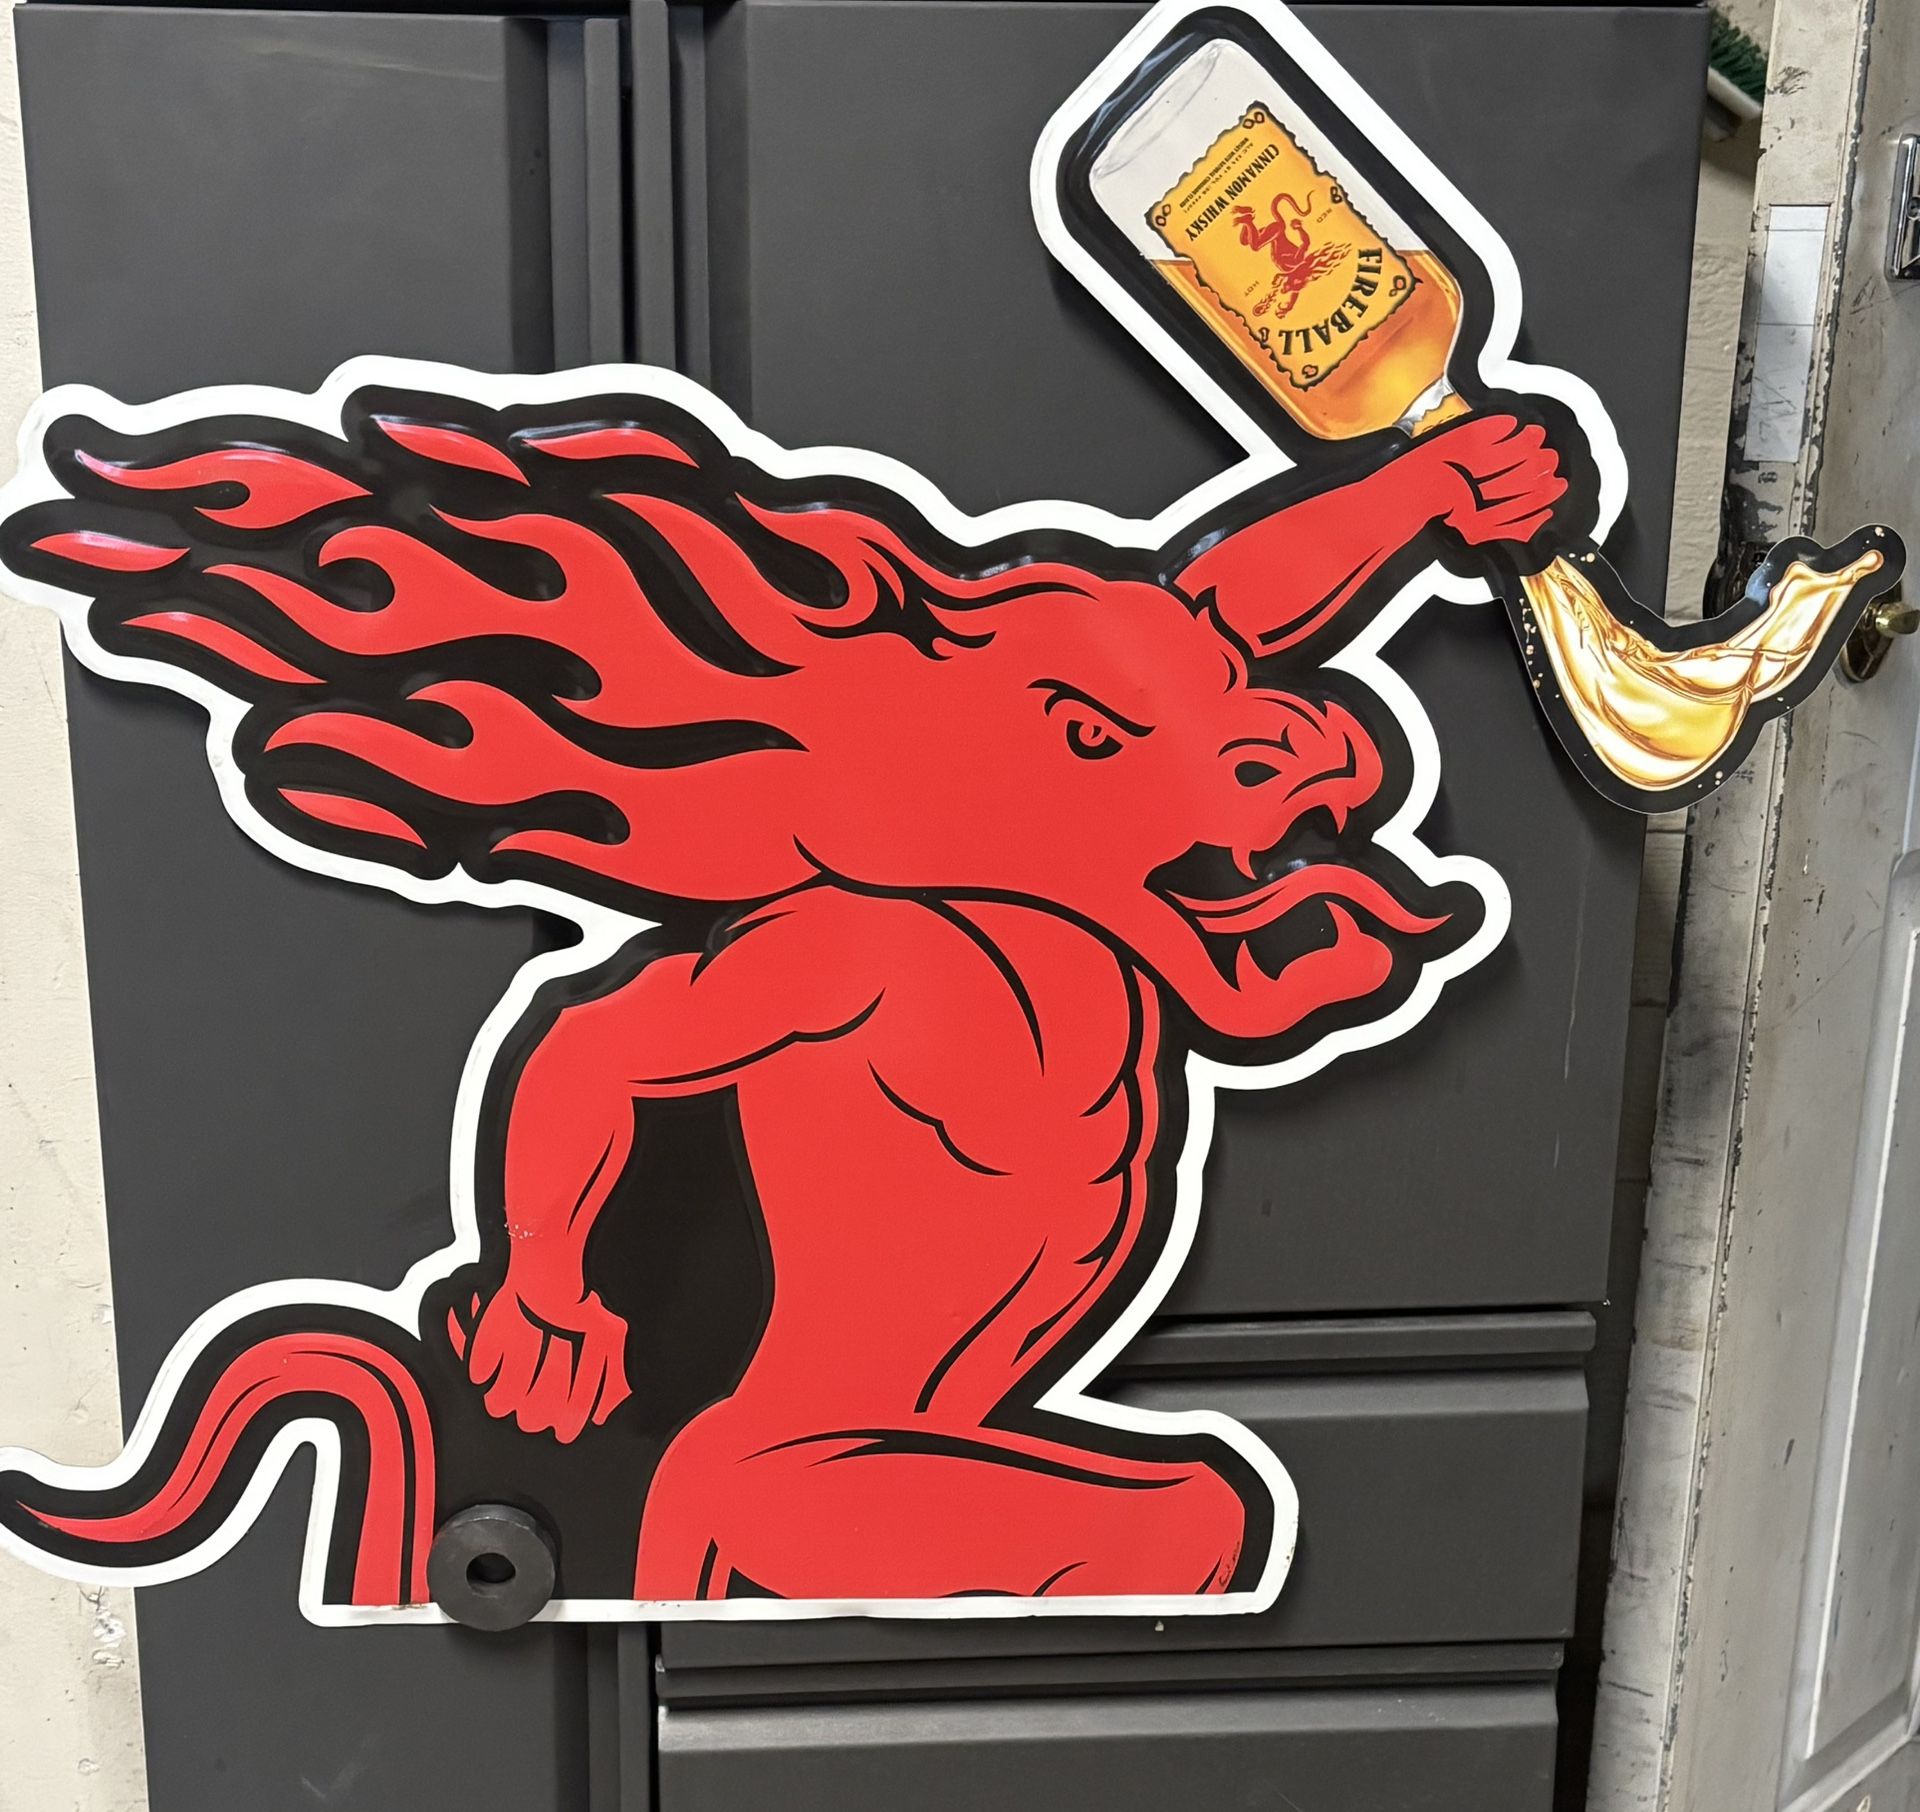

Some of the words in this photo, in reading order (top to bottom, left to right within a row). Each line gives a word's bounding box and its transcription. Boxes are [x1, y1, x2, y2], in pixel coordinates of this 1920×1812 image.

[1224, 144, 1280, 201] CINNAMON
[1185, 196, 1230, 241] WHISKY
[1244, 281, 1260, 297] HOT
[1278, 247, 1383, 355] FIREBALL
